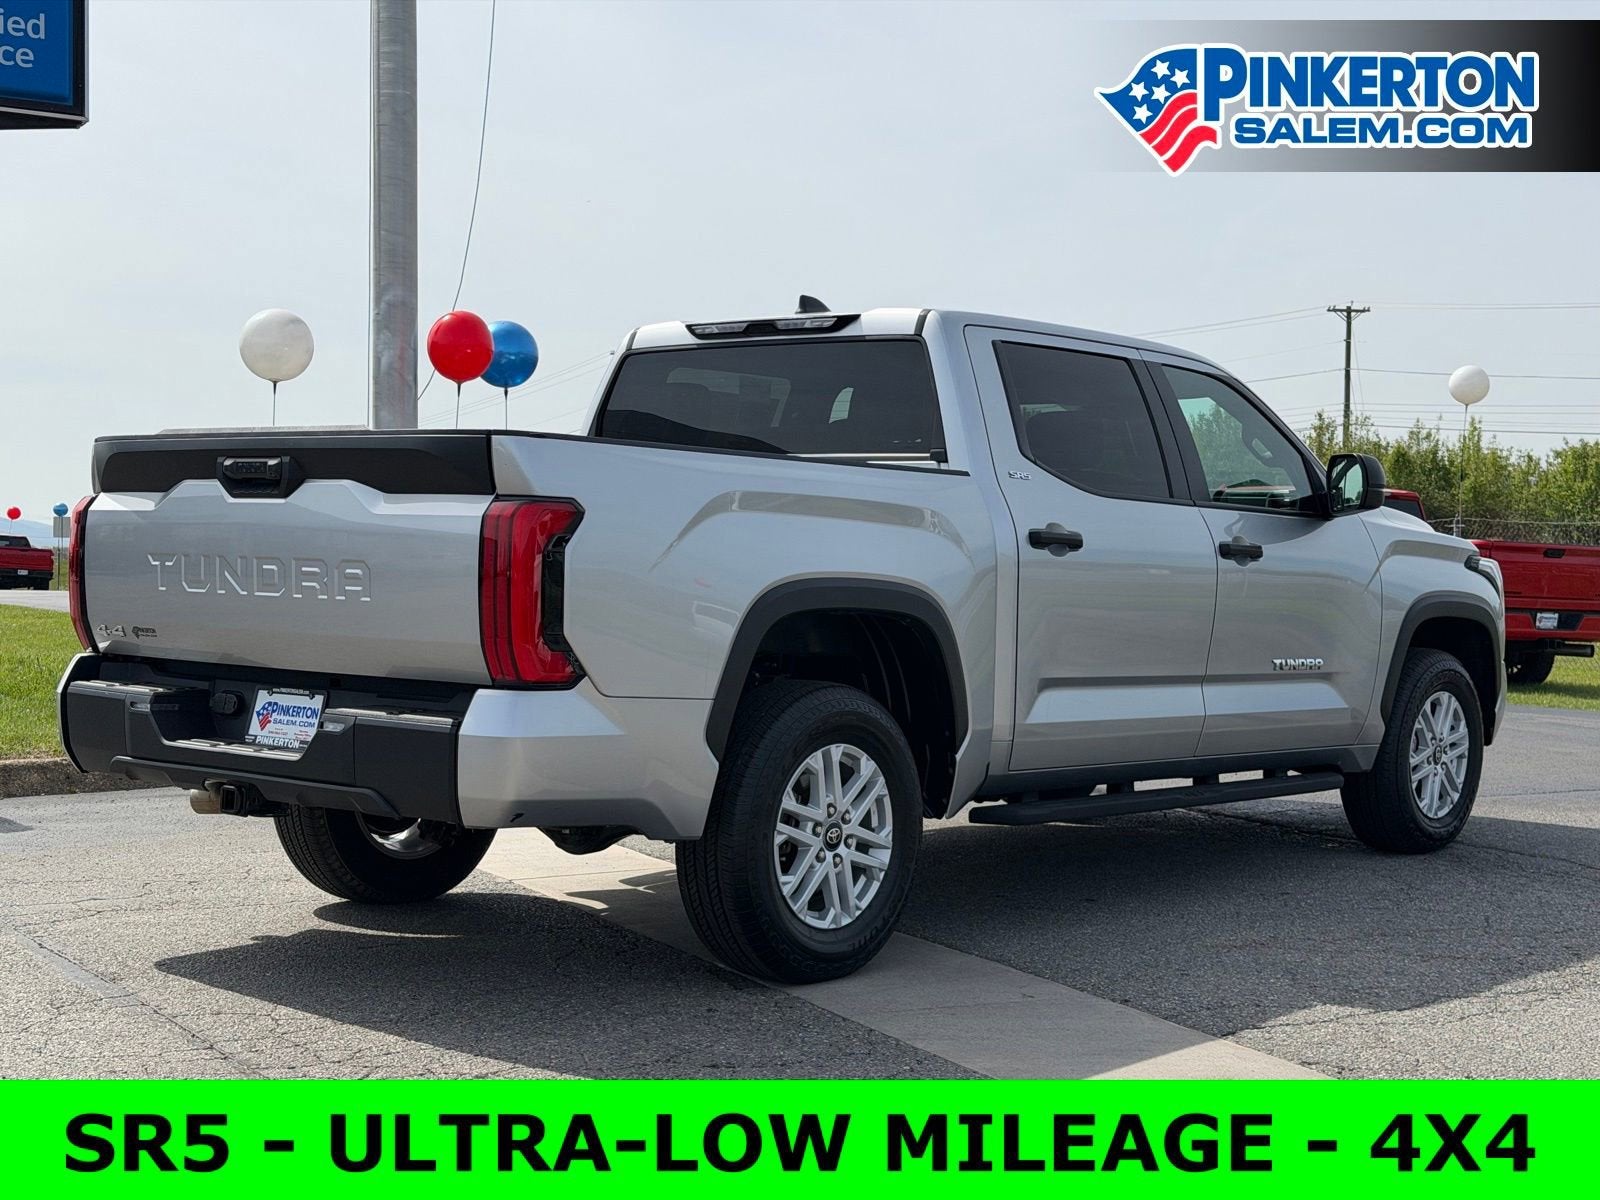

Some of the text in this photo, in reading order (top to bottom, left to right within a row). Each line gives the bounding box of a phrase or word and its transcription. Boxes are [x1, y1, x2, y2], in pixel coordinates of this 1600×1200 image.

[1008, 470, 1032, 481] SR5
[147, 552, 372, 602] TUNDRA
[1271, 658, 1325, 671] TUNDRA
[271, 701, 320, 720] PINKERTON
[272, 717, 316, 728] SALEM.COM
[255, 735, 300, 749] PINKERTON
